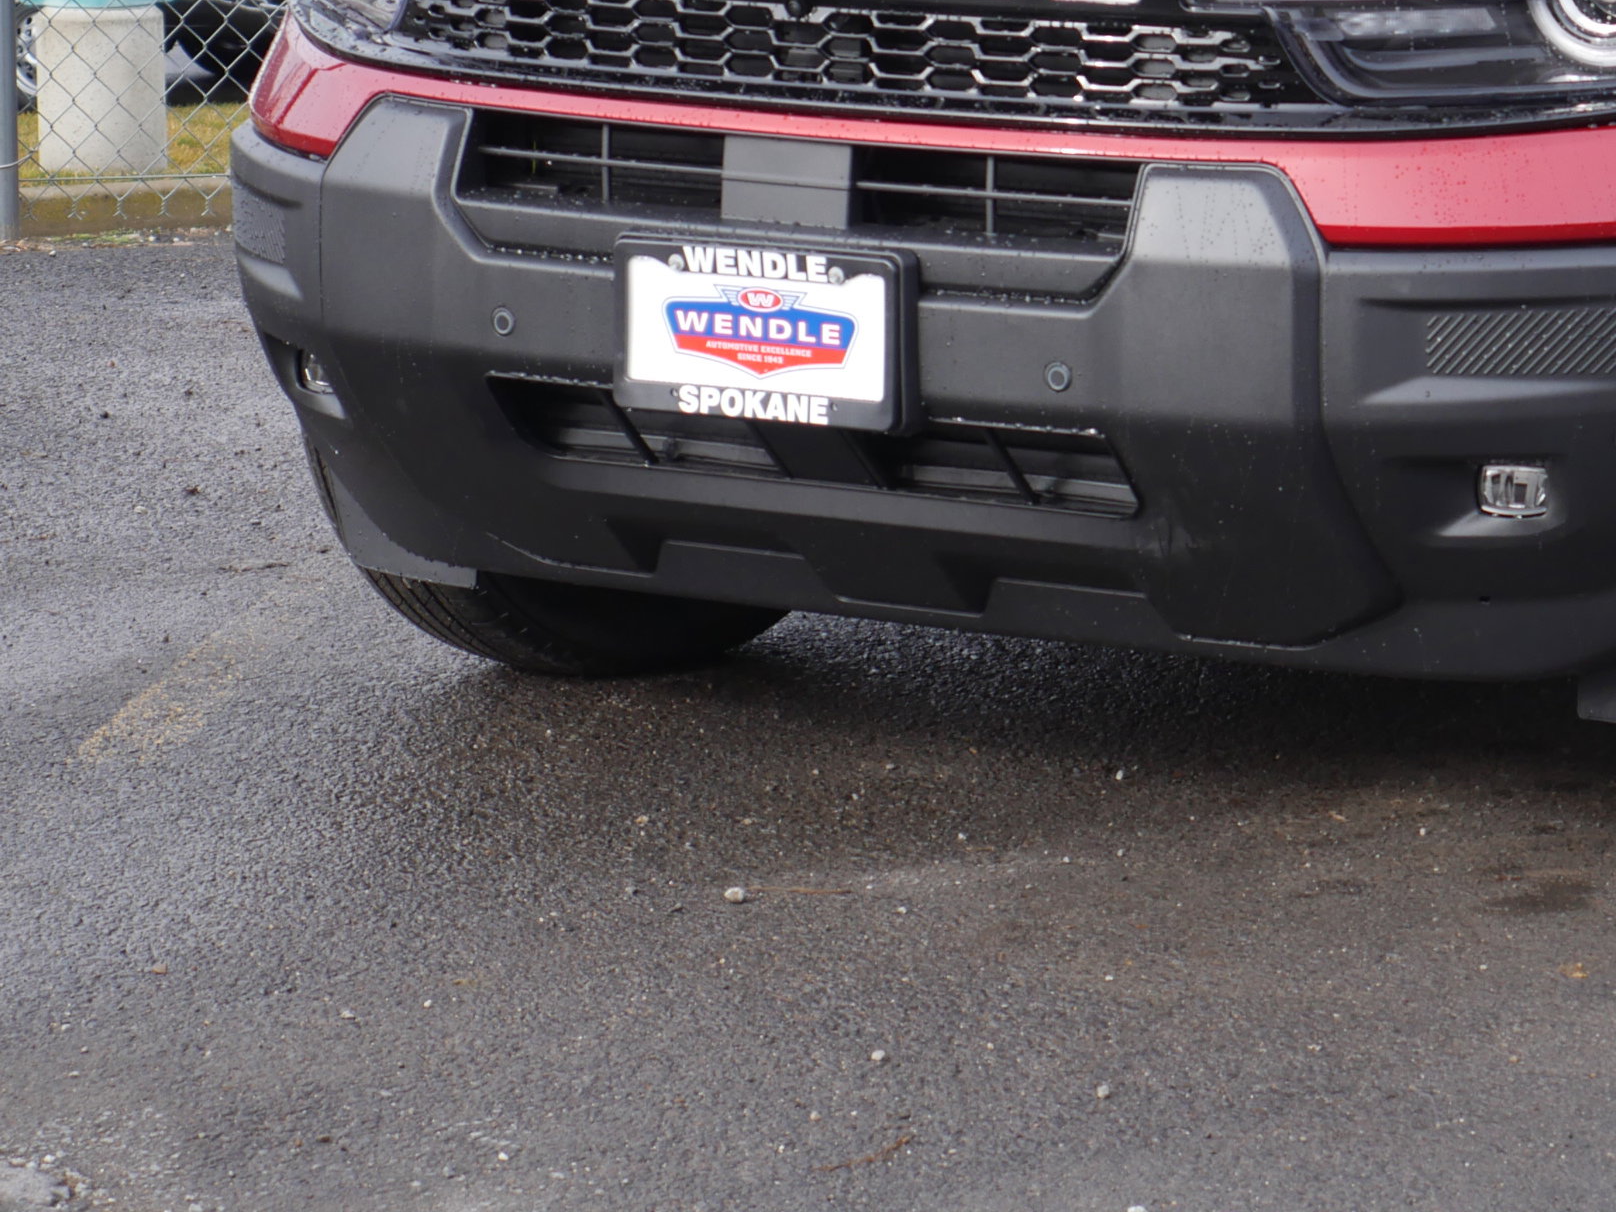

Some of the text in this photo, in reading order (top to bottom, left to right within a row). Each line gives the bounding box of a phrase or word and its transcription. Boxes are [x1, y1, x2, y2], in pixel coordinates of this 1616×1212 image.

[682, 245, 829, 284] WENDLE
[675, 309, 841, 345] WENDLE
[705, 340, 812, 358] AUTOMOTIVE EXCELLENCE
[737, 353, 762, 363] SINCE
[678, 385, 830, 425] SPOKANE
